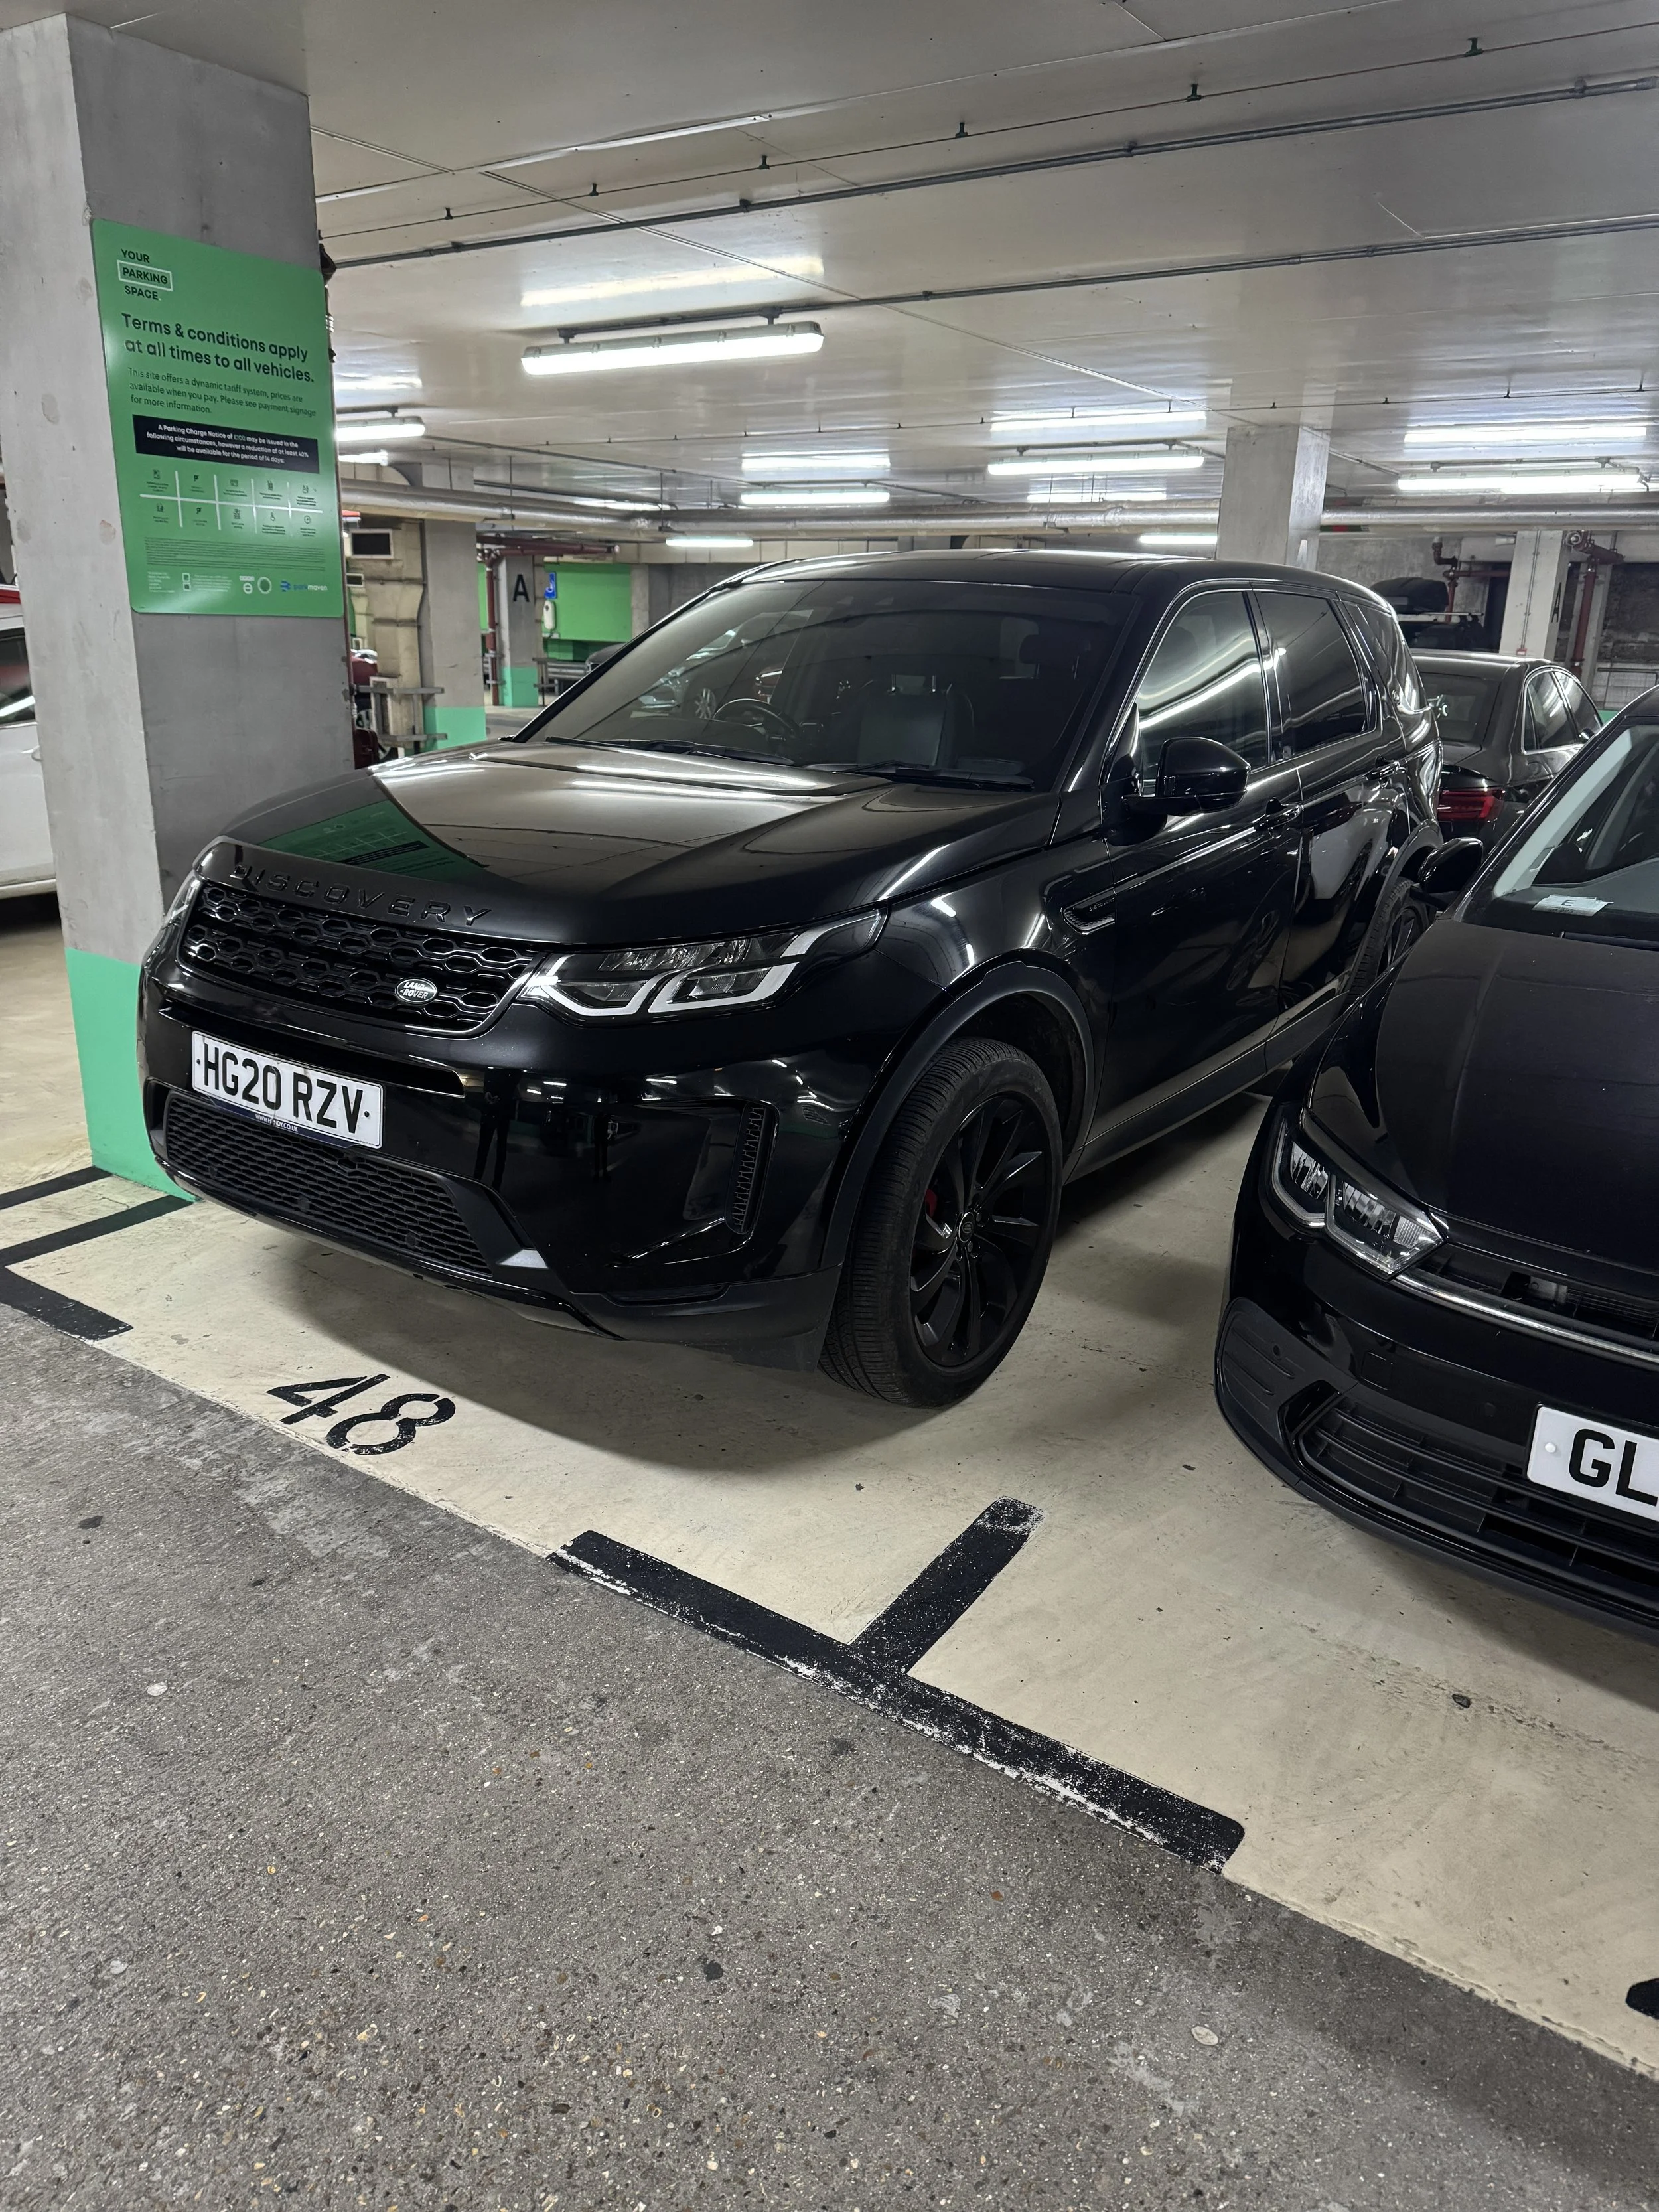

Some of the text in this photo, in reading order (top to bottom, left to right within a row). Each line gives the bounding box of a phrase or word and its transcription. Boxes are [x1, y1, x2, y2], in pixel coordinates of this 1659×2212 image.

[121, 248, 150, 263] YOUR
[123, 267, 168, 284] PARKING
[125, 285, 161, 301] SPACE.
[121, 313, 308, 363] Terms & conditions apply
[125, 340, 314, 382] at all times to all vehicles.
[127, 367, 143, 377] This
[146, 371, 159, 380] site
[161, 373, 183, 384] offers
[192, 378, 222, 390] dynamic
[224, 384, 241, 392] tariff
[243, 387, 269, 398] system,
[271, 392, 291, 400] prices
[129, 382, 165, 394] available
[166, 388, 186, 397] when
[188, 392, 202, 400] you
[204, 394, 218, 404] pay.
[220, 395, 244, 406] Please
[258, 402, 288, 412] payment
[290, 406, 316, 417] signage
[131, 394, 212, 413] for more information.
[147, 431, 174, 442] following
[175, 436, 218, 447] circumstances,
[163, 425, 185, 434] Parking
[186, 428, 207, 437] Charge
[195, 447, 222, 456] available
[513, 574, 530, 602] A
[1551, 582, 1562, 623] A
[230, 865, 492, 926] DISCOVERY
[403, 981, 425, 990] LAND
[403, 988, 429, 999] ROVER
[204, 1043, 364, 1134] HG20 RZV
[266, 1374, 456, 1455] 48
[1569, 1428, 1658, 1507] GL
